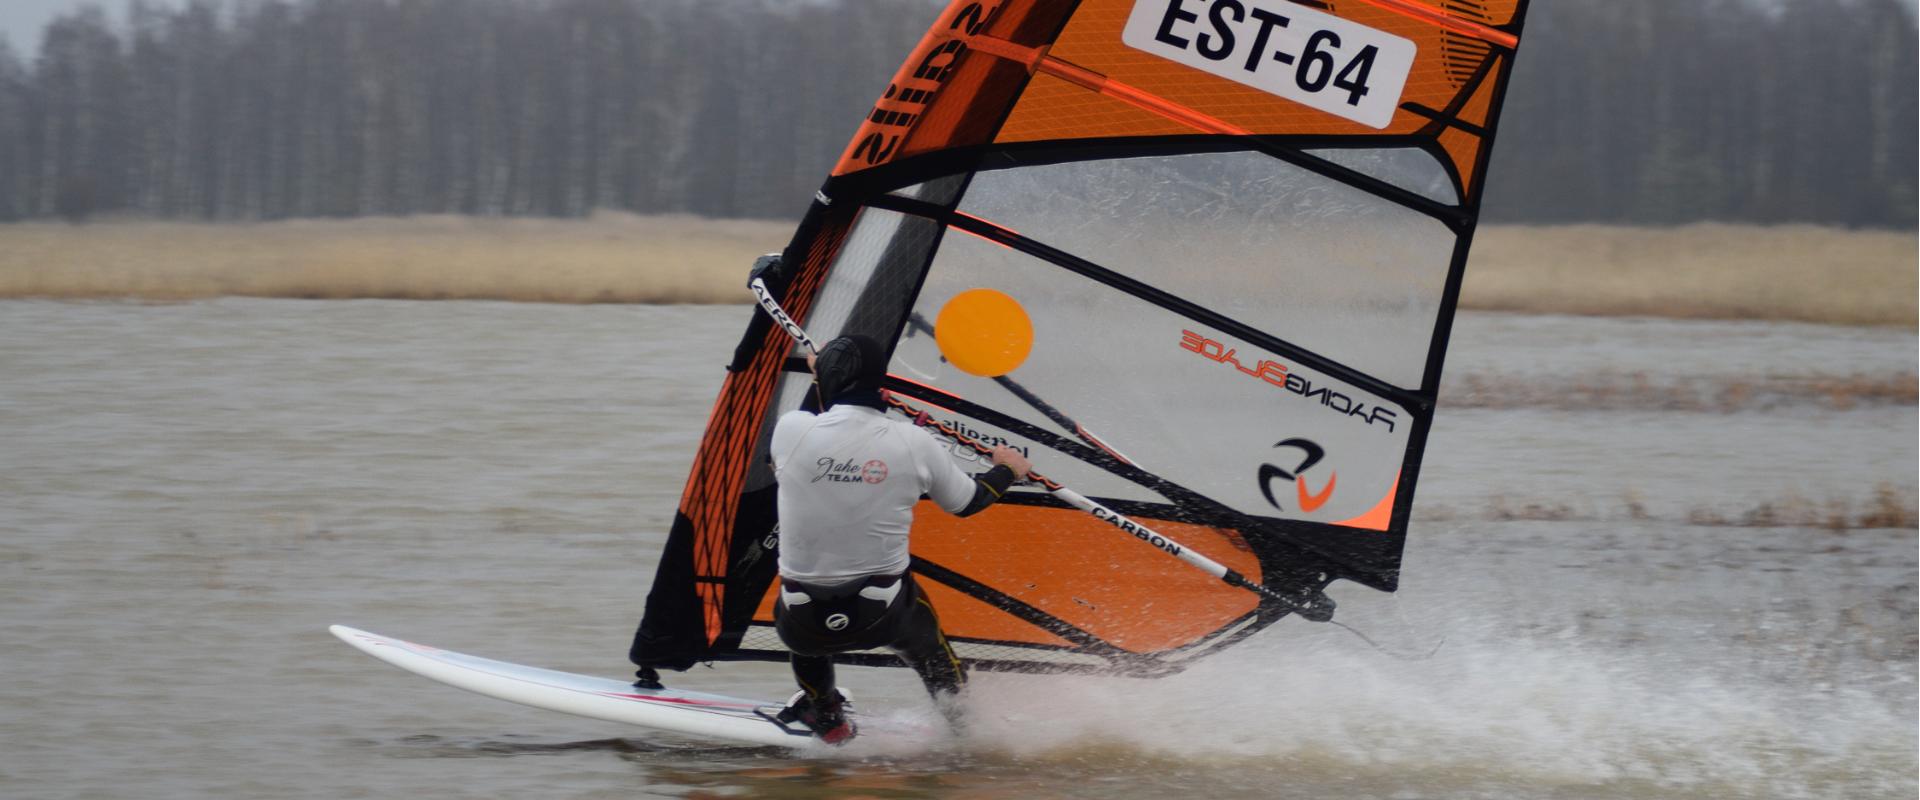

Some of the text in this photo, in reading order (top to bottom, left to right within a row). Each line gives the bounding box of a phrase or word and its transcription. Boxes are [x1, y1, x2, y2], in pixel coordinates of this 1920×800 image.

[1154, 0, 1380, 107] EST-64
[828, 473, 863, 483] TEAM
[1090, 506, 1181, 557] CARBON
